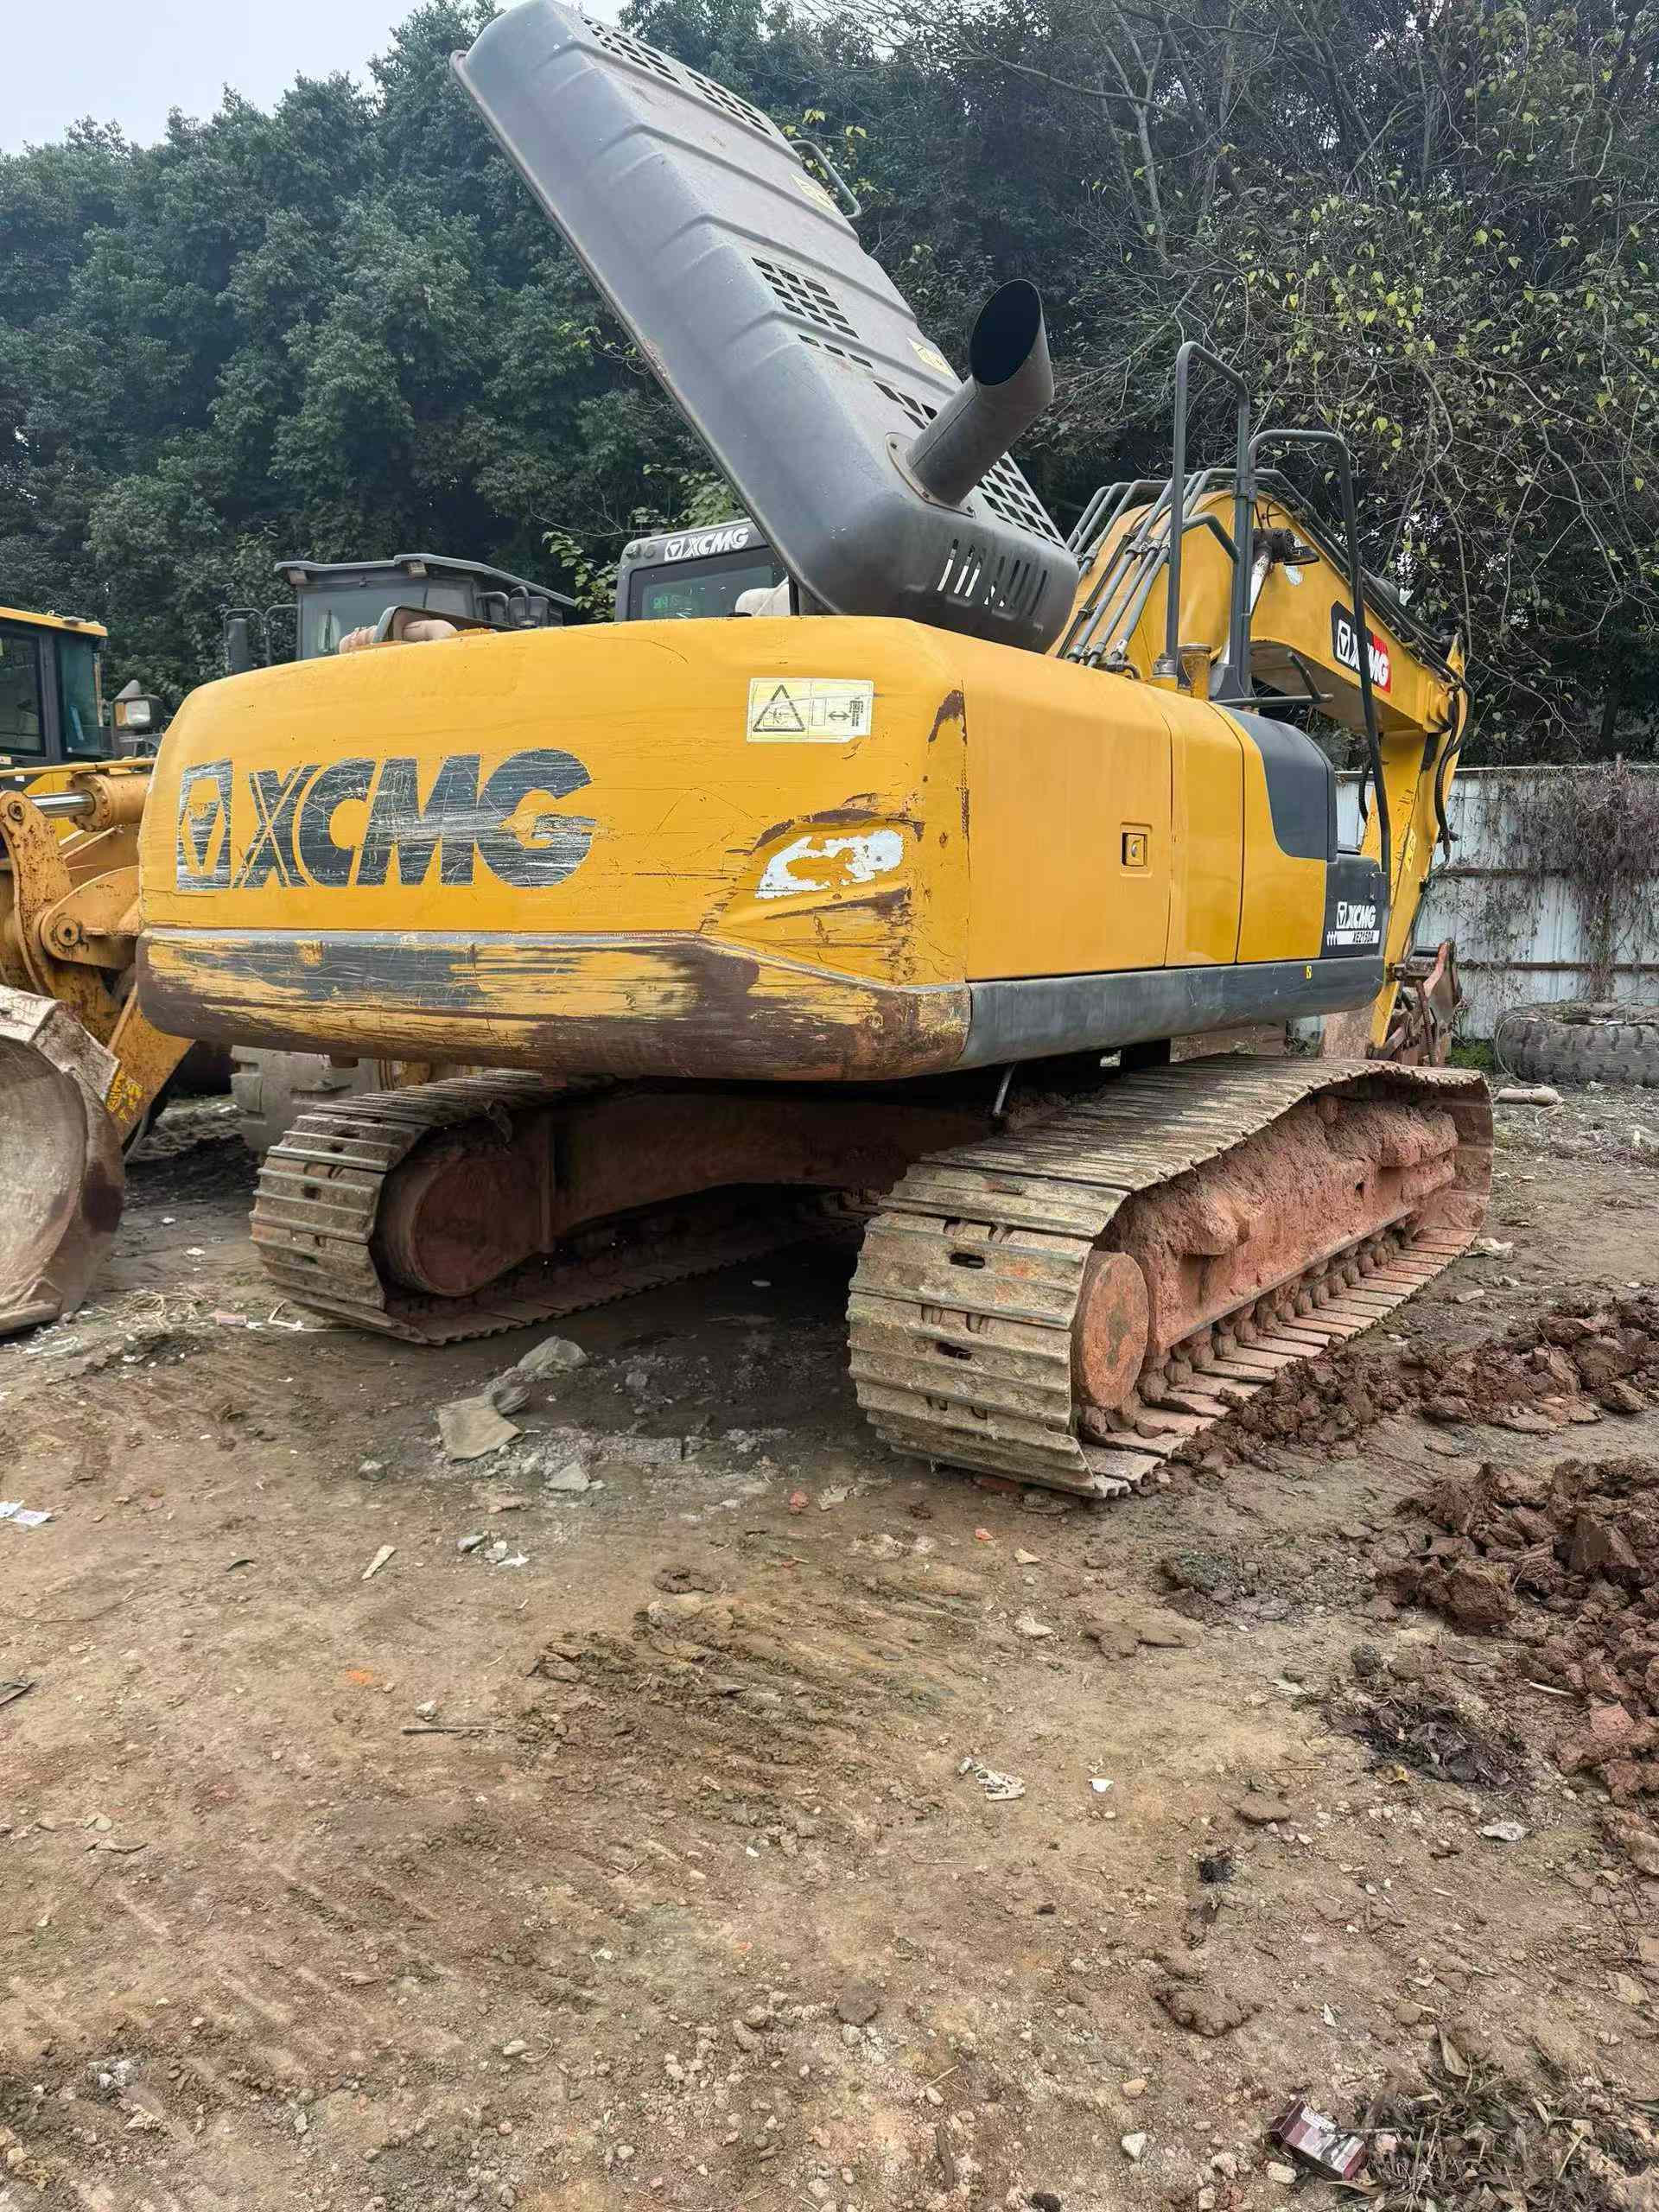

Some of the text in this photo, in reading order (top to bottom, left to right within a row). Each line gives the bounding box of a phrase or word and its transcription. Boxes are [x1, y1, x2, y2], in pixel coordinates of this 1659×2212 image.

[683, 527, 749, 559] XCMG
[1348, 632, 1389, 686] XMG
[230, 748, 597, 889] XCMG
[1345, 904, 1376, 930] XCMG
